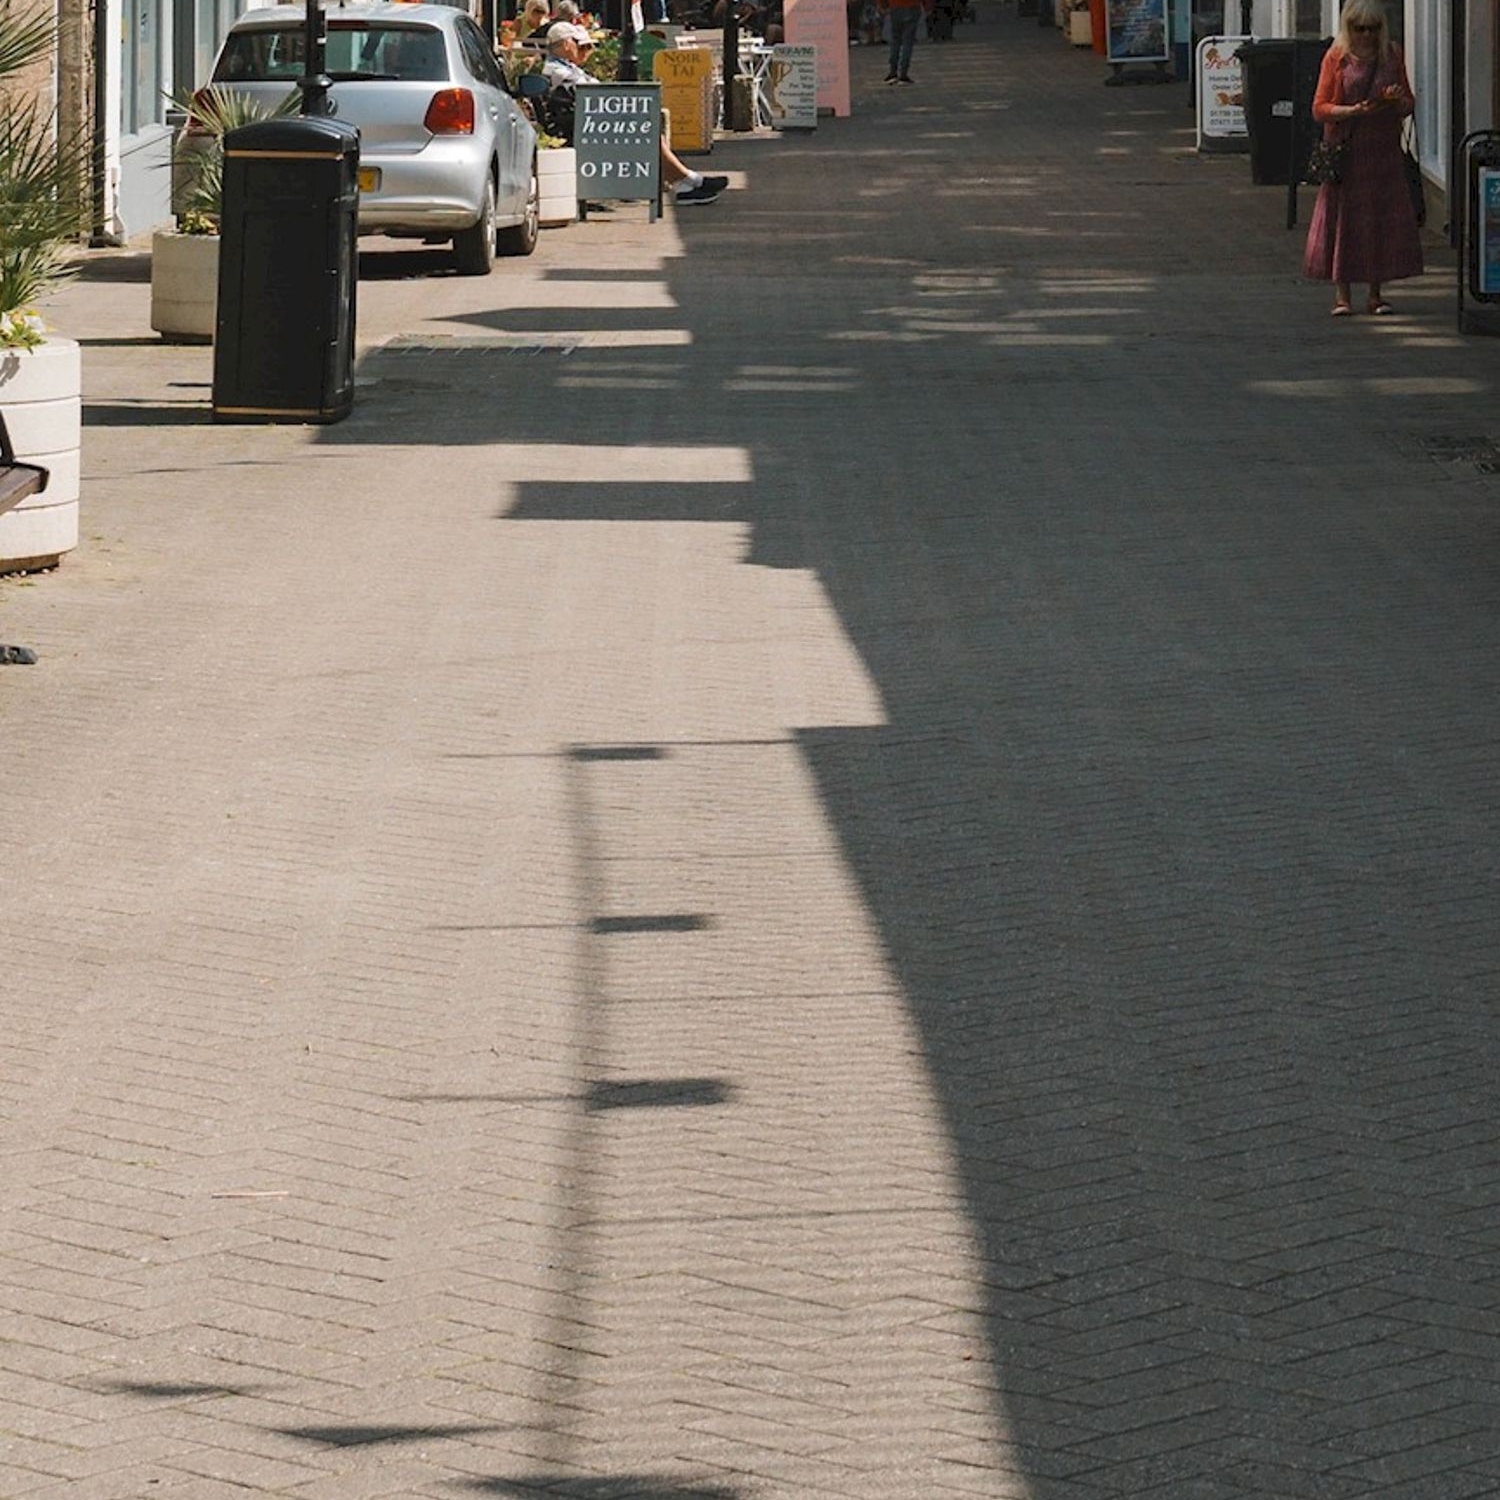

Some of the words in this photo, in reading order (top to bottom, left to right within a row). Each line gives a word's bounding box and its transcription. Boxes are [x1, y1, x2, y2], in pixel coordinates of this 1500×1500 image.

[583, 96, 653, 114] LIGHT
[582, 116, 652, 134] house
[580, 162, 650, 178] OPEN
